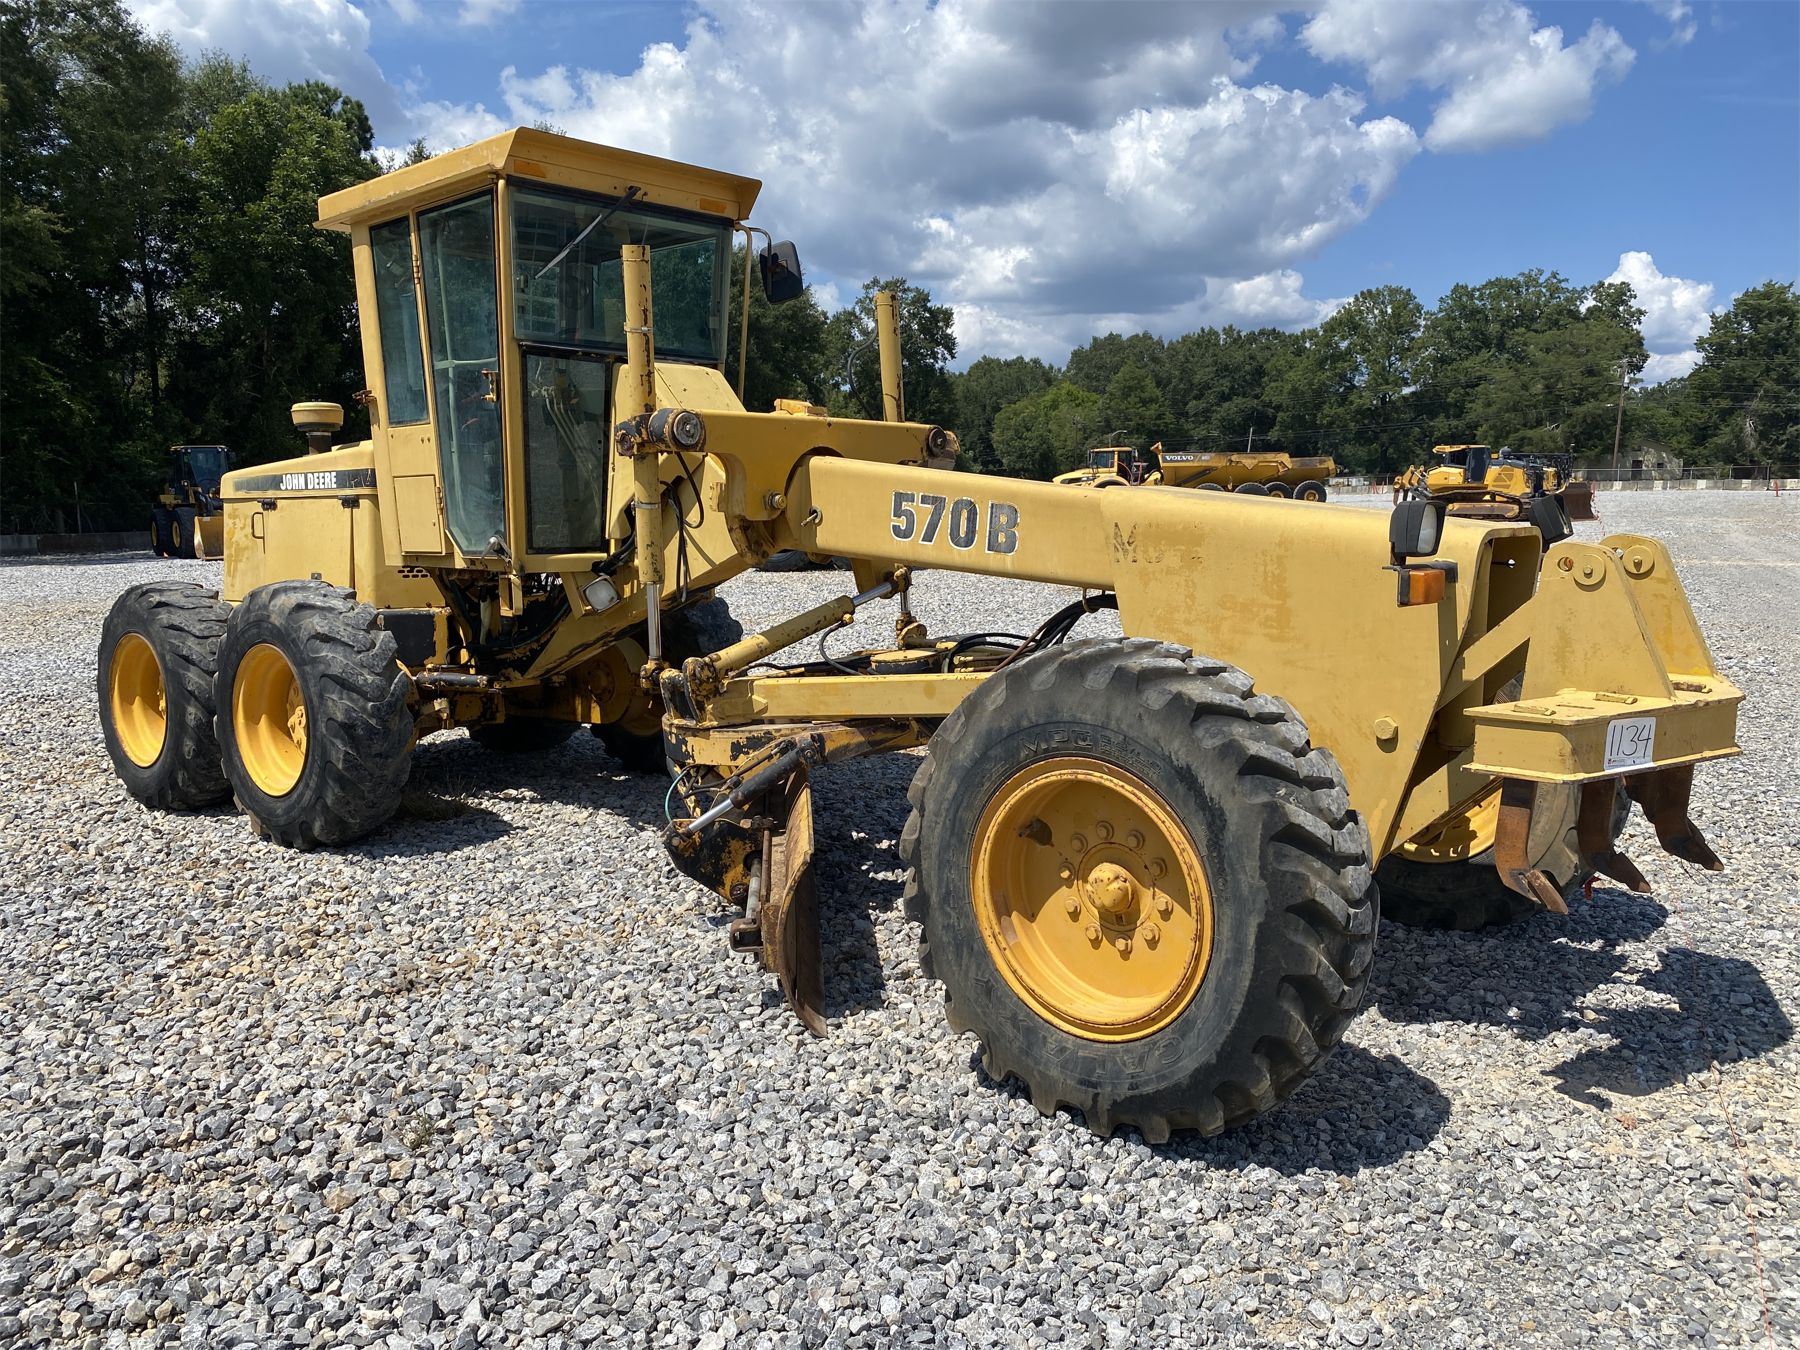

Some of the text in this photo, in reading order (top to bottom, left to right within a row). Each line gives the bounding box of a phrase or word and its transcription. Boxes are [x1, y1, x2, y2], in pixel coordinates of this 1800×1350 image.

[280, 471, 337, 490] JOHN DEERE
[1609, 724, 1652, 759] 1134
